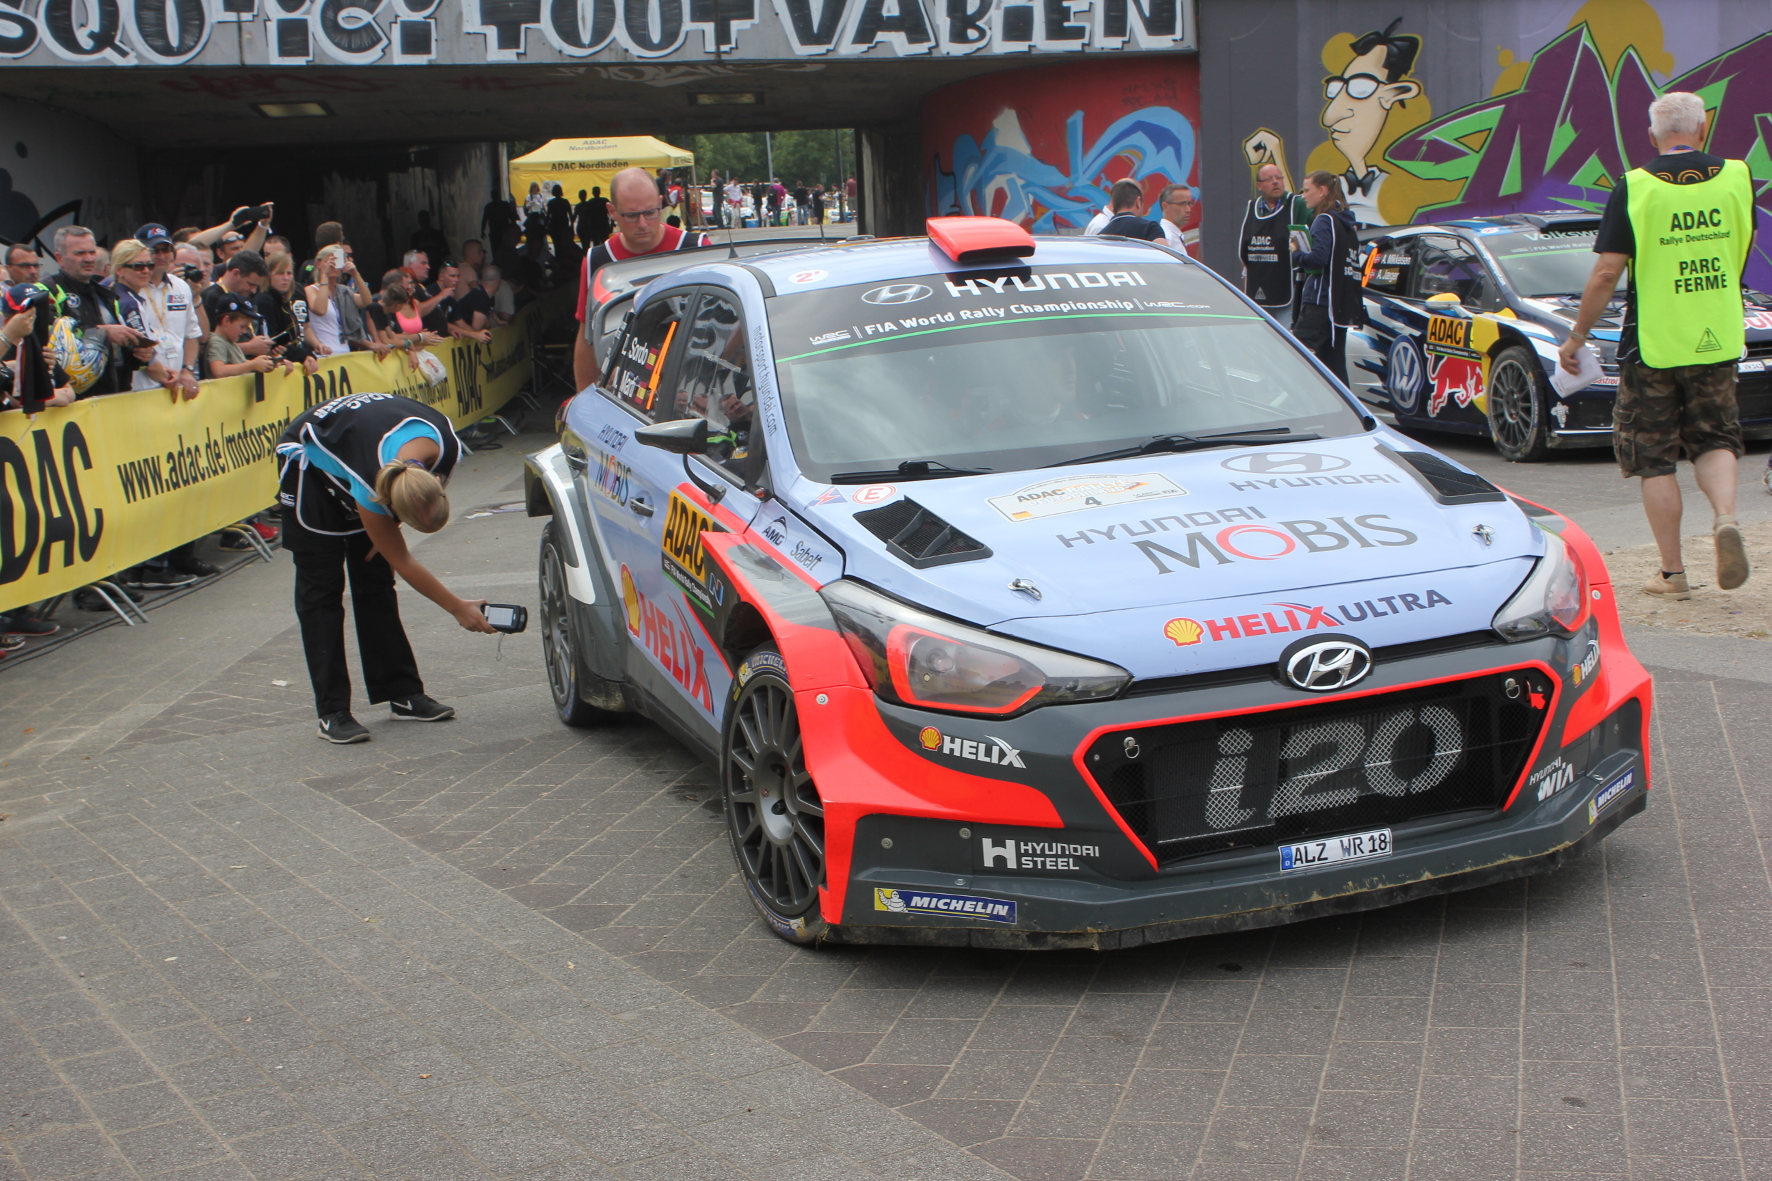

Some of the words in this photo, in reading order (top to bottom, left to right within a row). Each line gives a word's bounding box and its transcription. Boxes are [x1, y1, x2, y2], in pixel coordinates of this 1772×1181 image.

[551, 162, 577, 171] ADAC
[579, 160, 629, 170] Nordbaden
[1670, 208, 1722, 232] ADAC
[1250, 236, 1272, 246] ADAC
[1659, 235, 1684, 247] Rallye
[1679, 257, 1721, 276] PARC
[944, 271, 1148, 298] HYUNDAI
[864, 322, 898, 336] FIA
[898, 312, 955, 330] World
[958, 304, 1006, 321] Rally
[1009, 297, 1135, 316] Championship
[1428, 317, 1464, 346] ADAC
[752, 325, 778, 437] motorsport.hyundai.com
[598, 424, 629, 452] HYUNDAI
[594, 450, 632, 508] MOBIS
[1228, 473, 1402, 492] HYUNDAI
[1017, 488, 1067, 503] ADAC
[1084, 496, 1103, 507] 4
[1055, 505, 1268, 549] HYUNDAI
[1130, 513, 1418, 576] MOBIS
[1202, 602, 1340, 642] HELIX
[1337, 589, 1453, 623] ULTRA
[639, 591, 716, 717] HELIX
[943, 734, 1027, 770] HELIX
[1597, 772, 1633, 808] MICHELIN
[1020, 842, 1099, 858] HYUNDAI
[1294, 842, 1329, 866] ALZ
[1368, 832, 1388, 853] 18
[1021, 857, 1080, 870] STEEL
[910, 895, 1009, 918] MICHELIN
